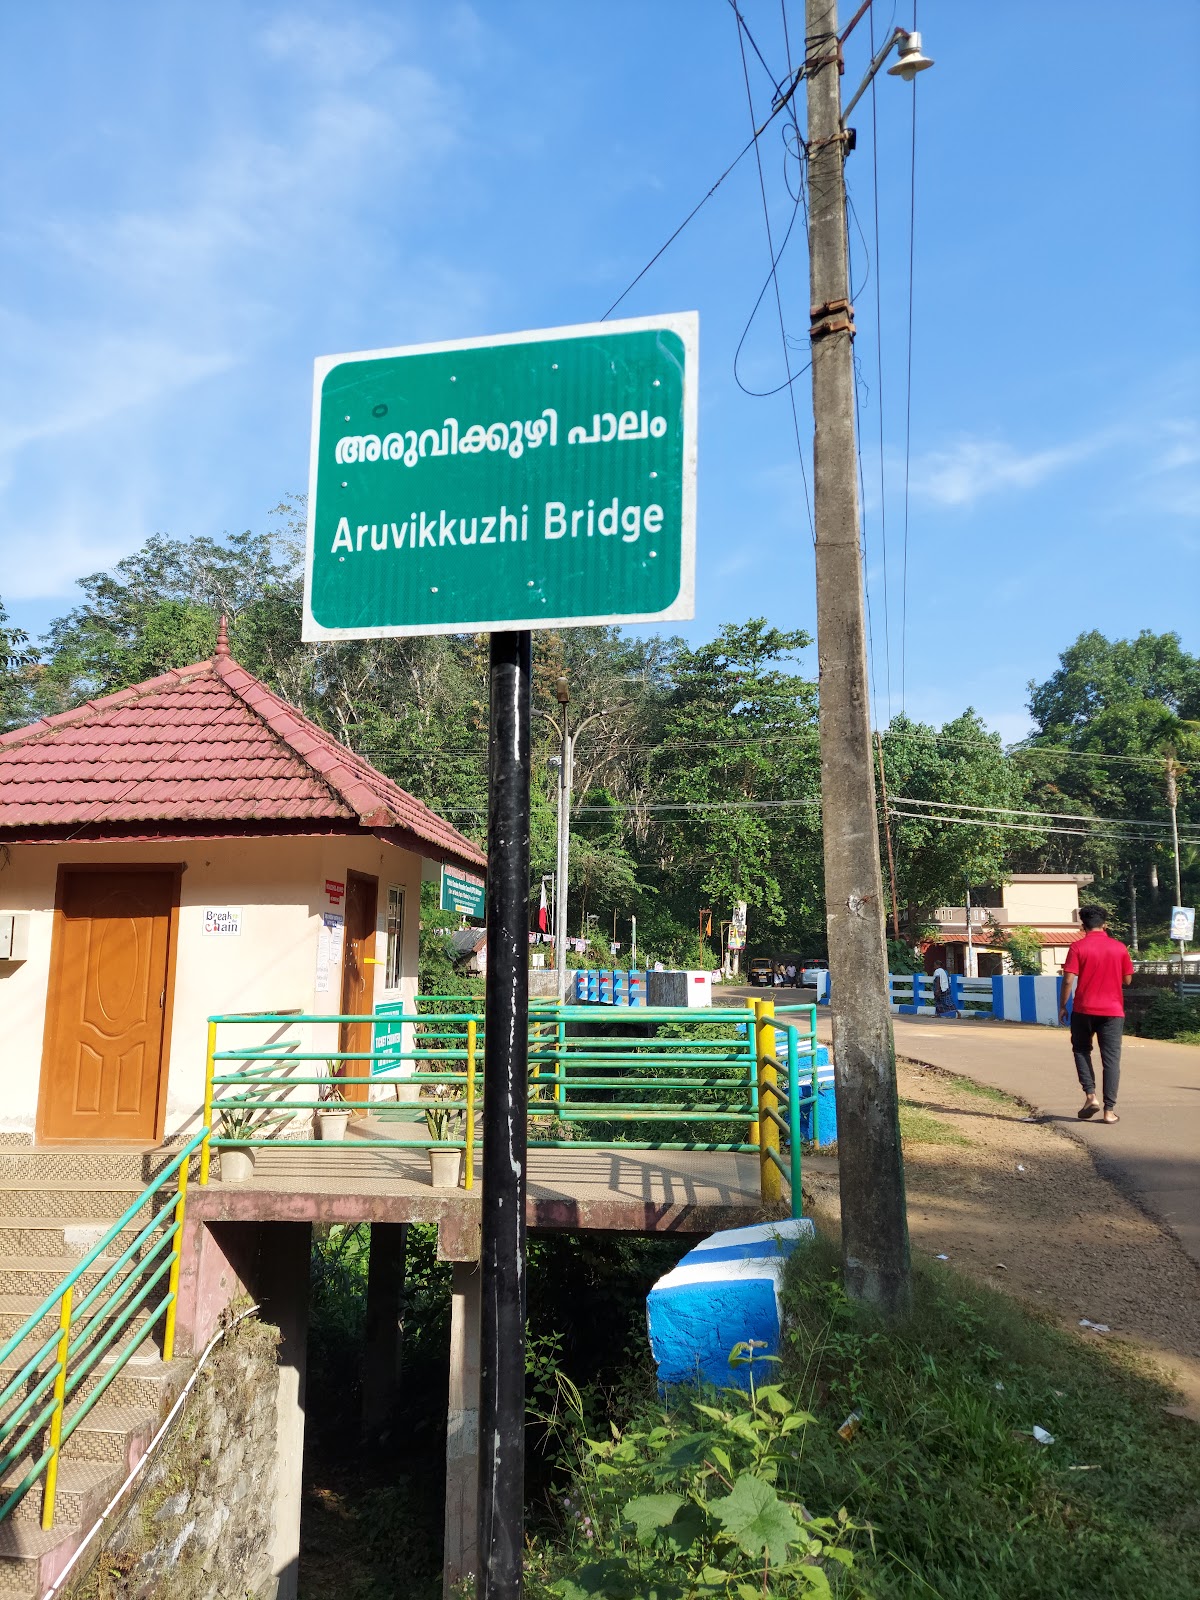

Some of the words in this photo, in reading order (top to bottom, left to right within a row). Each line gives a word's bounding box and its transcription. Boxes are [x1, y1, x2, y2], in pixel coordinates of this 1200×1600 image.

[335, 409, 558, 467] അരുവിക്കുഴി
[568, 410, 667, 444] പാലം
[331, 505, 529, 553] Aruvikkuzhi
[544, 497, 664, 543] Bridge
[206, 911, 232, 921] Break
